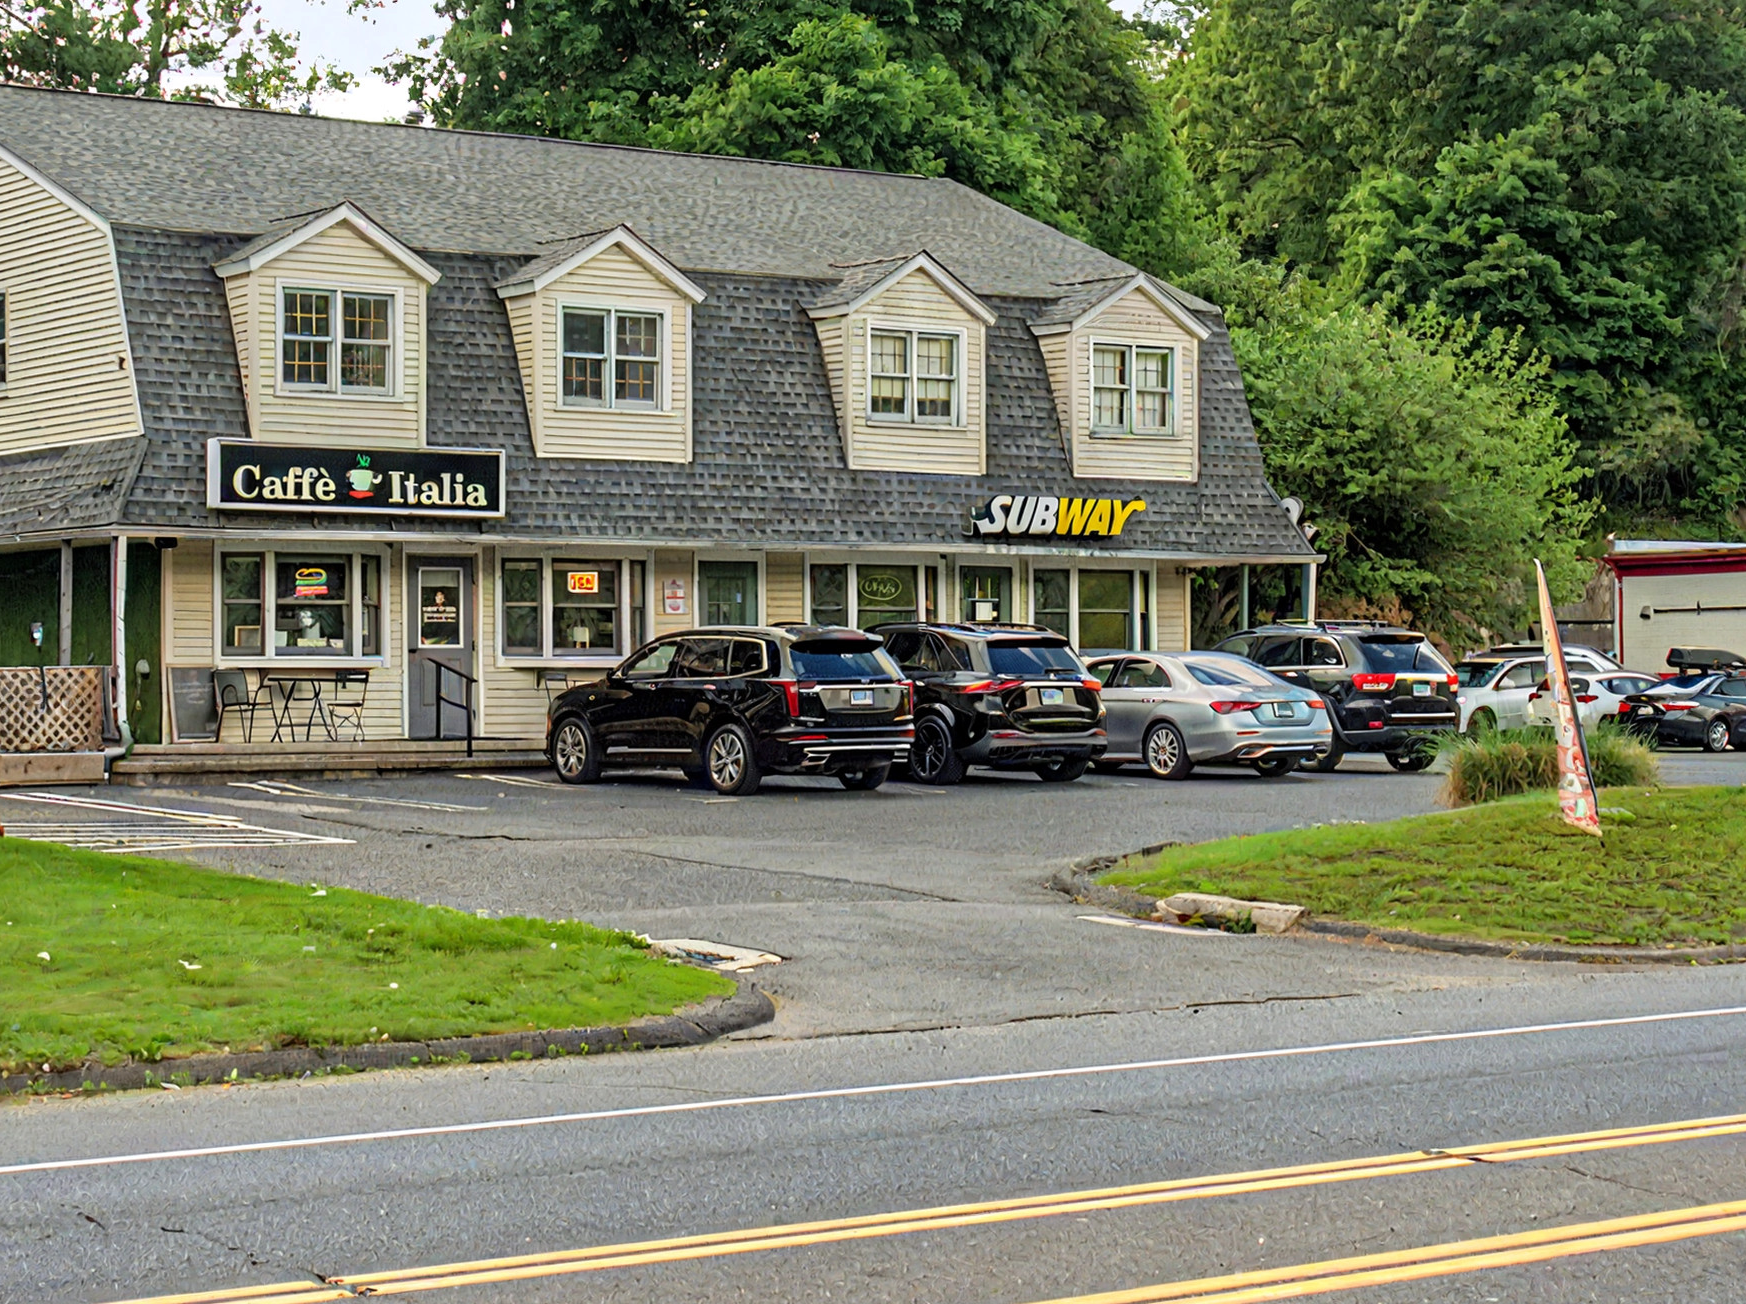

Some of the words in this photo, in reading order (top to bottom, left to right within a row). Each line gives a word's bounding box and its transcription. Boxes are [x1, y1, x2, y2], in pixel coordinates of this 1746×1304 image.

[232, 464, 336, 502] Caffè
[387, 470, 488, 507] Italia
[969, 494, 1146, 537] SUBWAY
